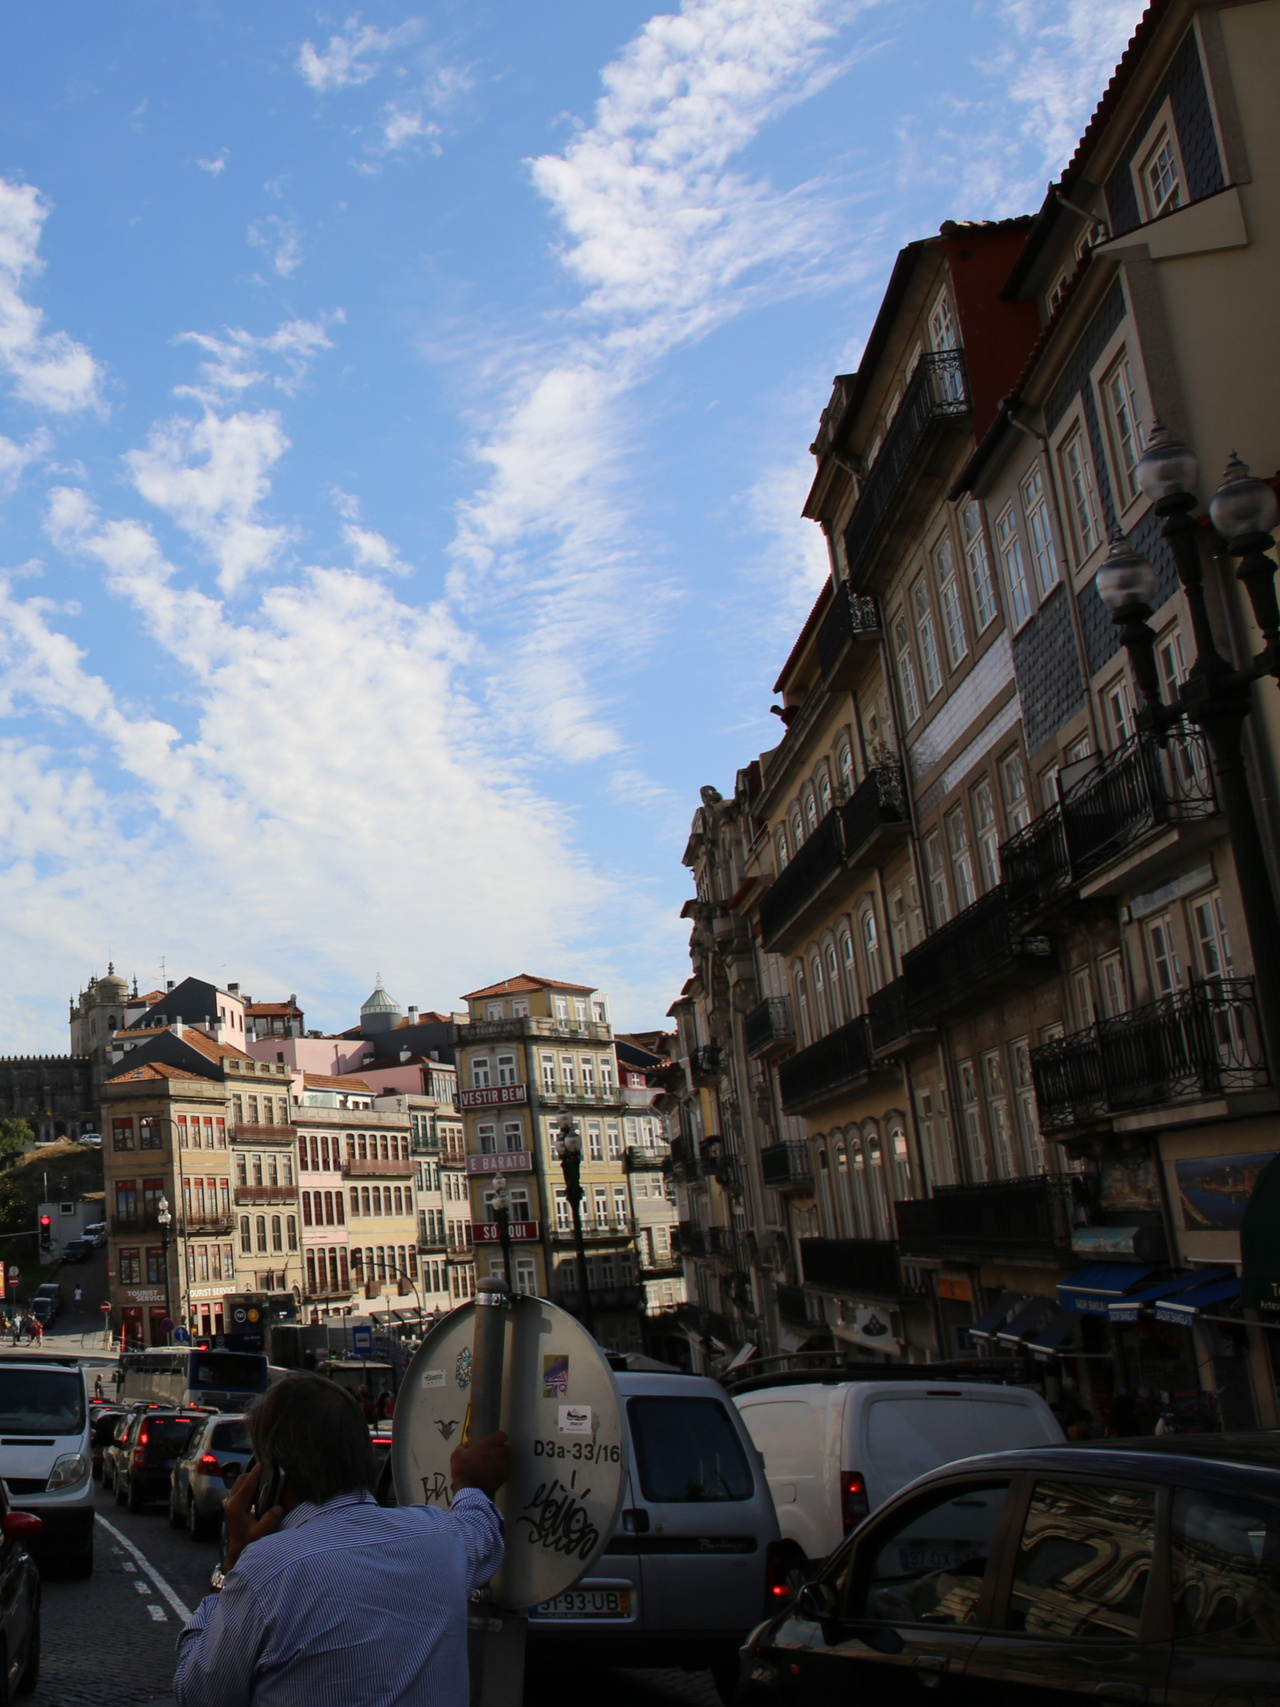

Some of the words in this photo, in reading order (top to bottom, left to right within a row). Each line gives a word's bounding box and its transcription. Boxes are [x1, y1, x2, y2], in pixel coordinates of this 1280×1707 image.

[462, 1090, 499, 1105] VESTIR
[501, 1087, 524, 1102] BEM
[470, 1158, 477, 1171] E
[482, 1155, 526, 1170] BARATO
[483, 1224, 497, 1239] SÓ
[501, 1224, 526, 1239] QUI
[187, 1288, 211, 1298] OURIST
[212, 1286, 236, 1296] SERVICE
[533, 1439, 620, 1464] D3a-33/16
